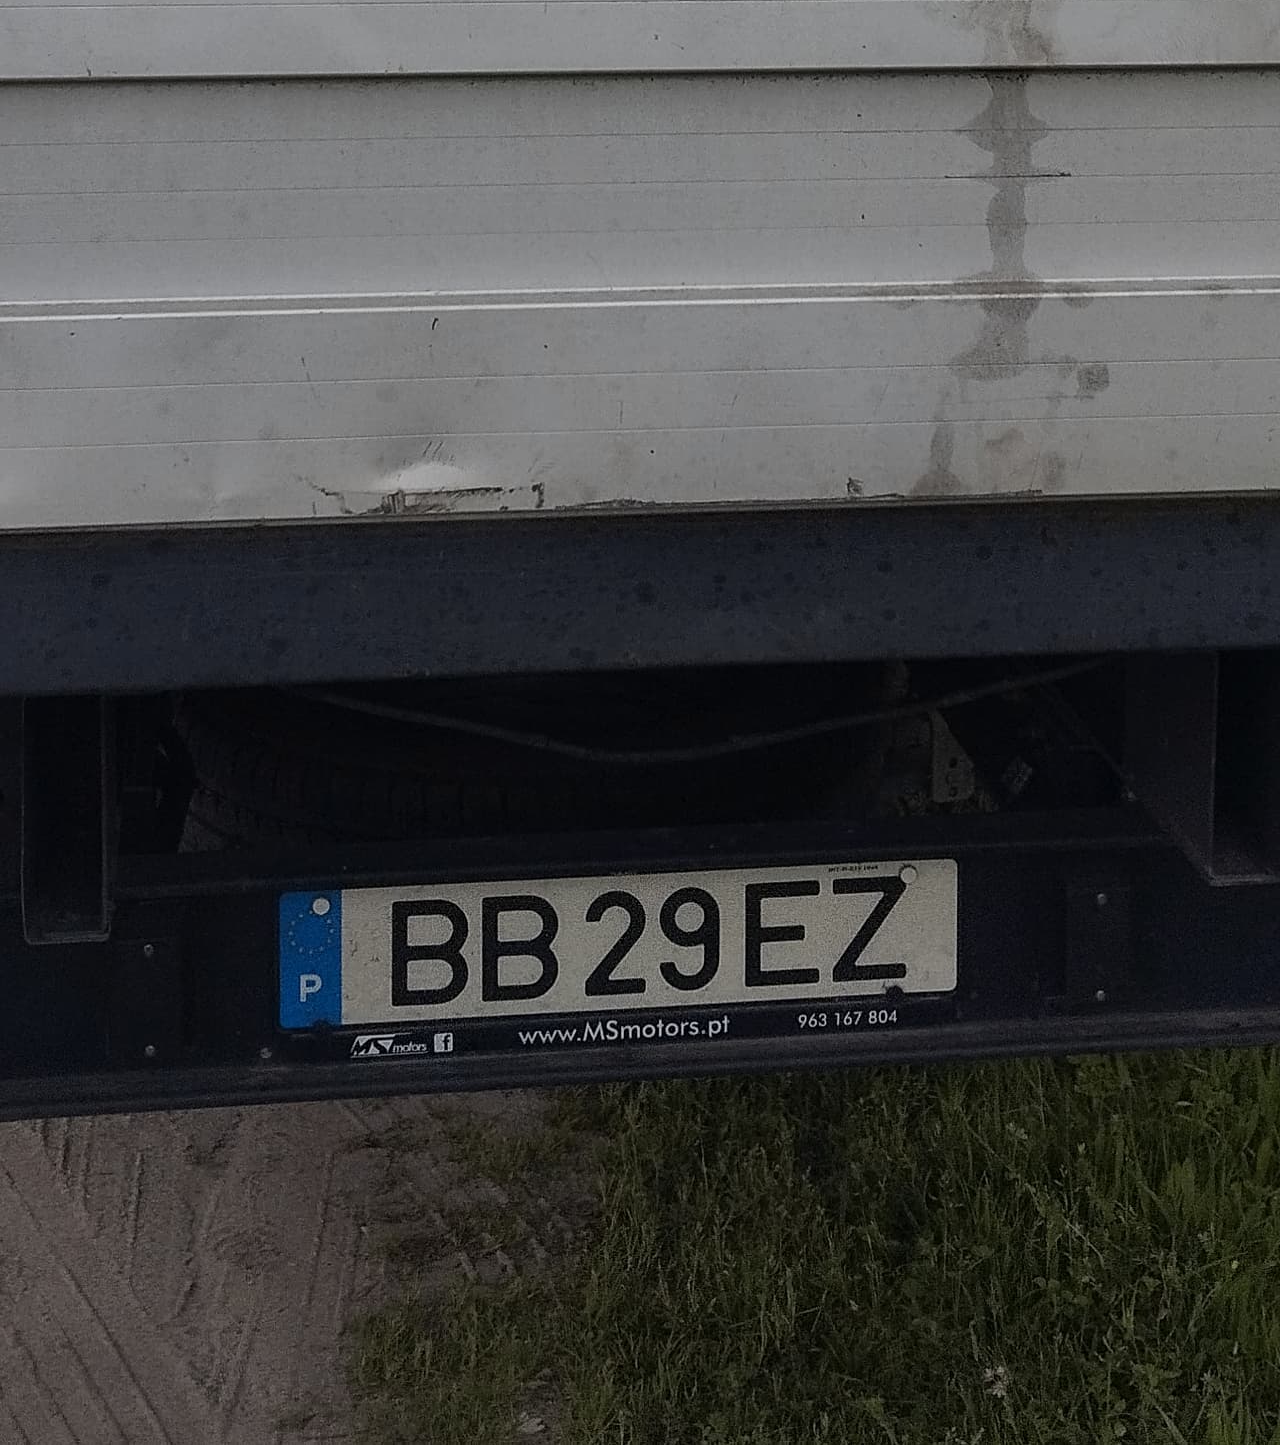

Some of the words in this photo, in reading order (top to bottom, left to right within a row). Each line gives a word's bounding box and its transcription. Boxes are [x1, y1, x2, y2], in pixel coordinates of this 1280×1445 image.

[299, 974, 322, 1003] P
[519, 1017, 731, 1046] www.MSmotors.pt
[798, 1014, 827, 1029] 963
[834, 1012, 862, 1027] 167
[869, 1010, 897, 1024] 804
